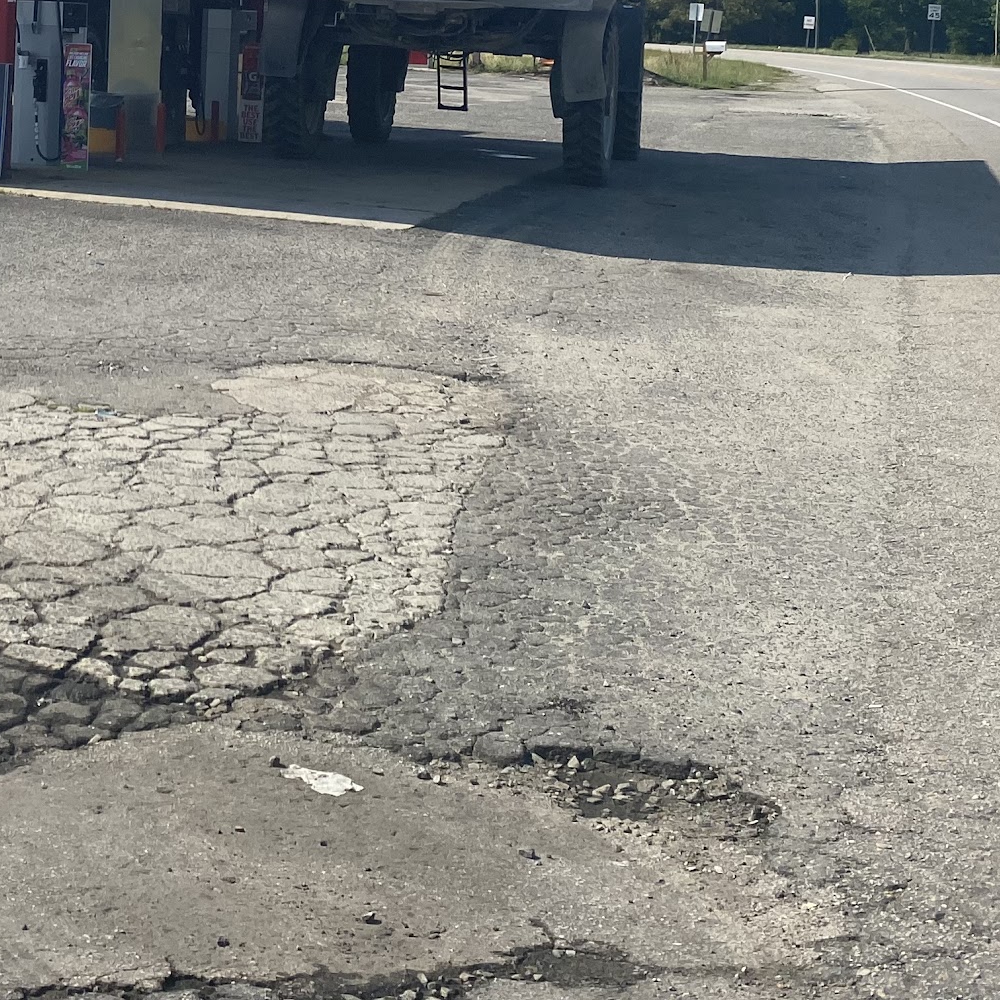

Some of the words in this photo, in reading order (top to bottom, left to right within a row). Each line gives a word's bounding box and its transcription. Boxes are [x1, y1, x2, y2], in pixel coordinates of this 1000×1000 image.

[248, 72, 258, 82] G
[243, 125, 257, 133] THE
[240, 132, 259, 140] BEST
